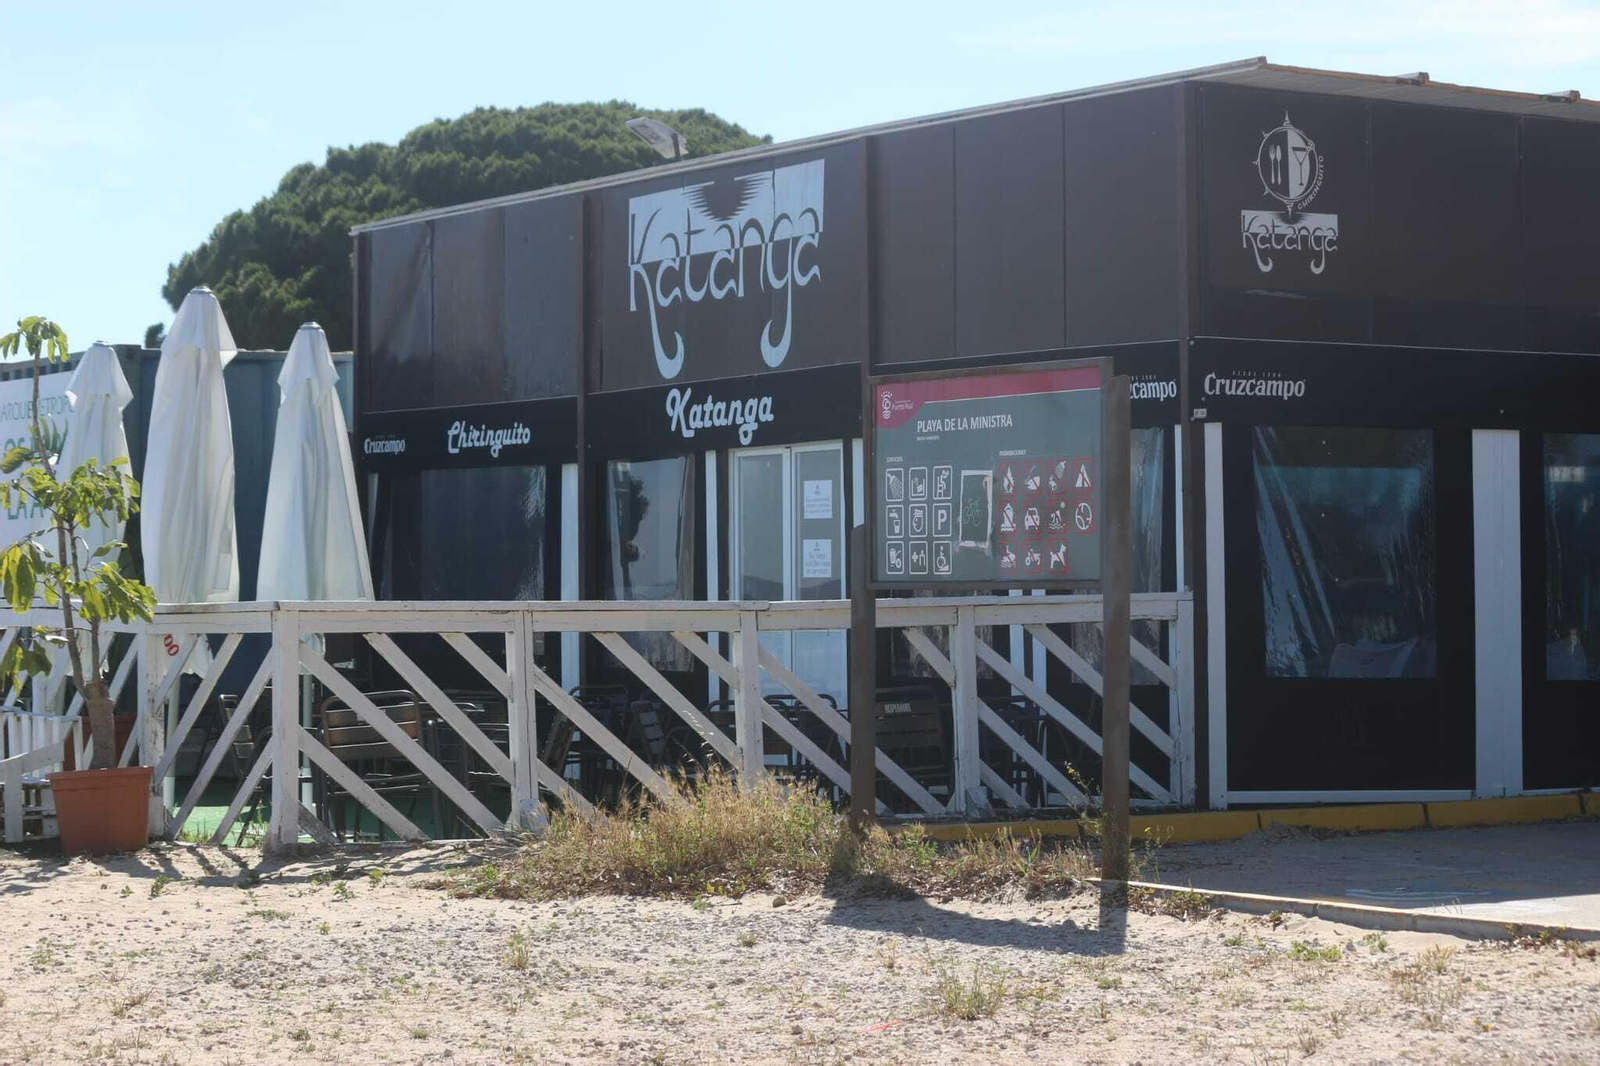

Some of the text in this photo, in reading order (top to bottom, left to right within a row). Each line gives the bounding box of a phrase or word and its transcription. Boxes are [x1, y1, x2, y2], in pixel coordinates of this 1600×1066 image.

[1298, 155, 1324, 210] CHIRINGUITO
[1241, 212, 1338, 274] Katanga
[629, 206, 821, 379] Katanga
[1130, 380, 1177, 402] campo
[1204, 371, 1306, 400] Cruzcampo
[666, 387, 774, 446] Katanga
[917, 414, 1013, 433] PLAYA DE LA MINISTRA
[364, 437, 406, 455] Cruzcampo
[447, 420, 531, 458] Chiringuito
